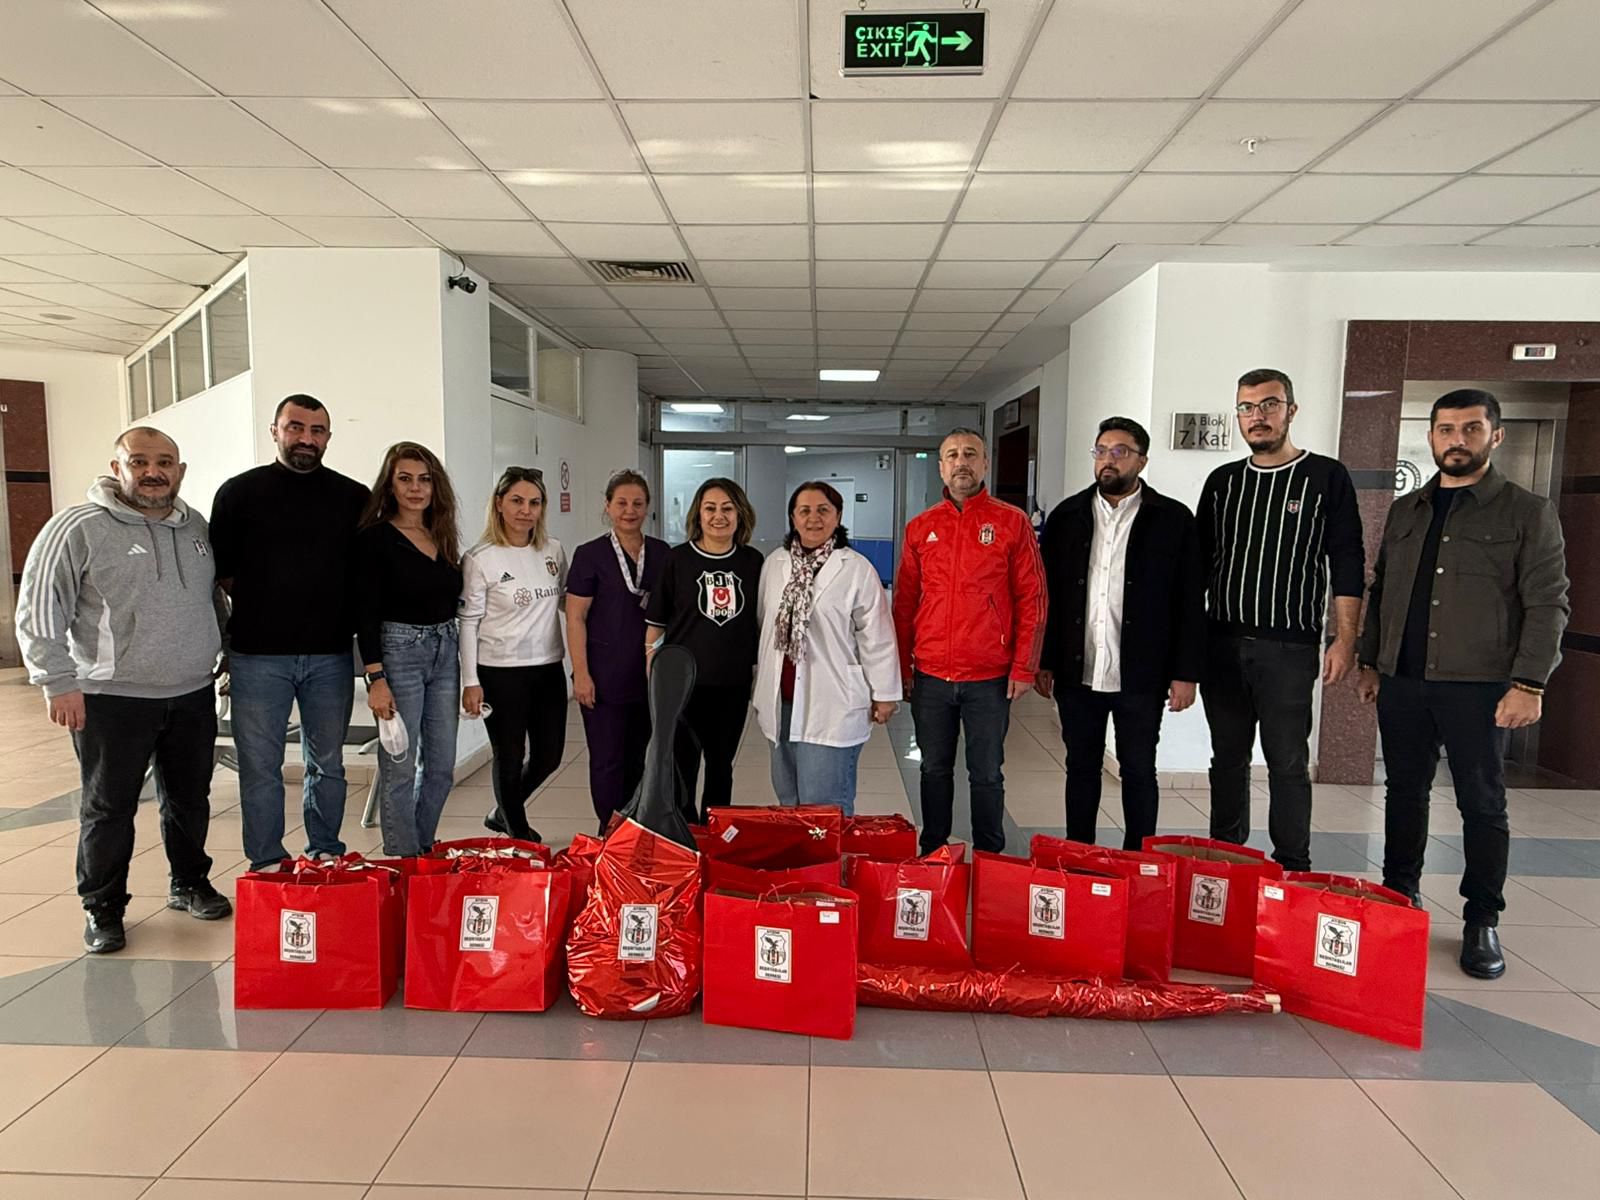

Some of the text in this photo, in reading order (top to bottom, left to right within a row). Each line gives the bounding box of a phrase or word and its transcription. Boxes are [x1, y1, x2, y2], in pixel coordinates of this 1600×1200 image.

[855, 26, 905, 42] ÇIKIŞ
[856, 43, 904, 58] EXIT
[1188, 416, 1225, 426] A Blok
[706, 575, 734, 586] BJK
[534, 585, 560, 599] Rain
